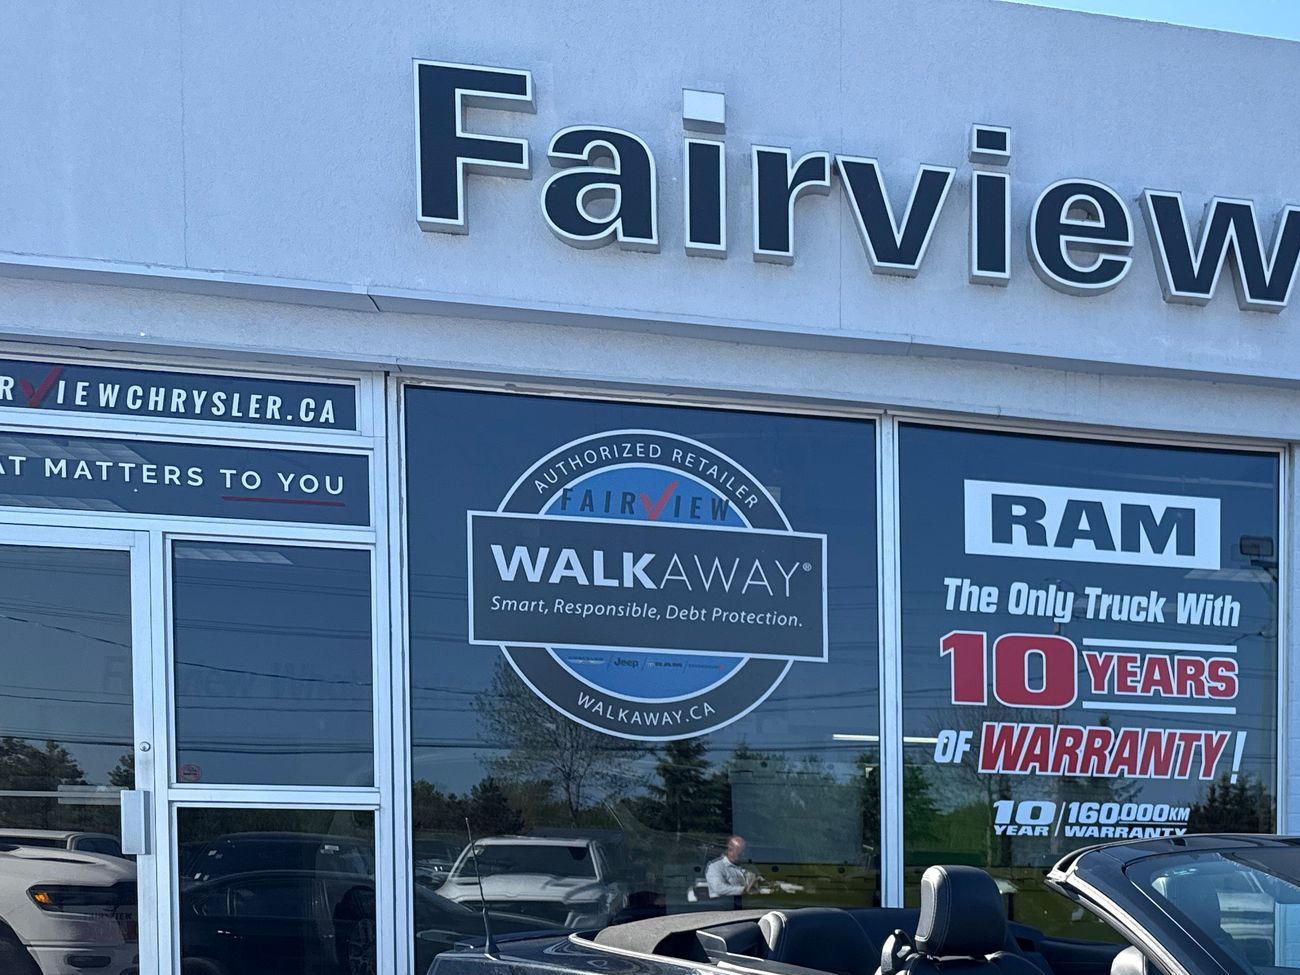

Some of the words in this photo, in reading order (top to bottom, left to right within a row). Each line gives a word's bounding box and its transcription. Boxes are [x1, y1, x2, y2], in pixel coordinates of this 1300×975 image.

[44, 458, 204, 487] MATTERS
[220, 469, 262, 490] TO
[277, 472, 345, 495] YOU
[533, 443, 662, 494] AUTHORIZED
[672, 448, 758, 509] RETAILER
[560, 480, 731, 522] FAIRVIEW
[990, 493, 1196, 557] RAM
[490, 595, 549, 616] Smart,
[553, 599, 662, 621] Responsible,
[666, 605, 707, 621] Debt
[711, 607, 804, 628] Protection.
[943, 577, 999, 614] The
[1008, 581, 1075, 624] Only
[1084, 586, 1167, 624] Truck
[1176, 593, 1241, 627] With
[613, 657, 639, 669] Jeep
[939, 629, 1078, 709] 10
[1082, 650, 1239, 700] YEARS
[577, 691, 716, 727] WALKAWAY.CA
[933, 729, 973, 764] OF
[992, 800, 1057, 826] 10
[993, 825, 1050, 837] YEAR
